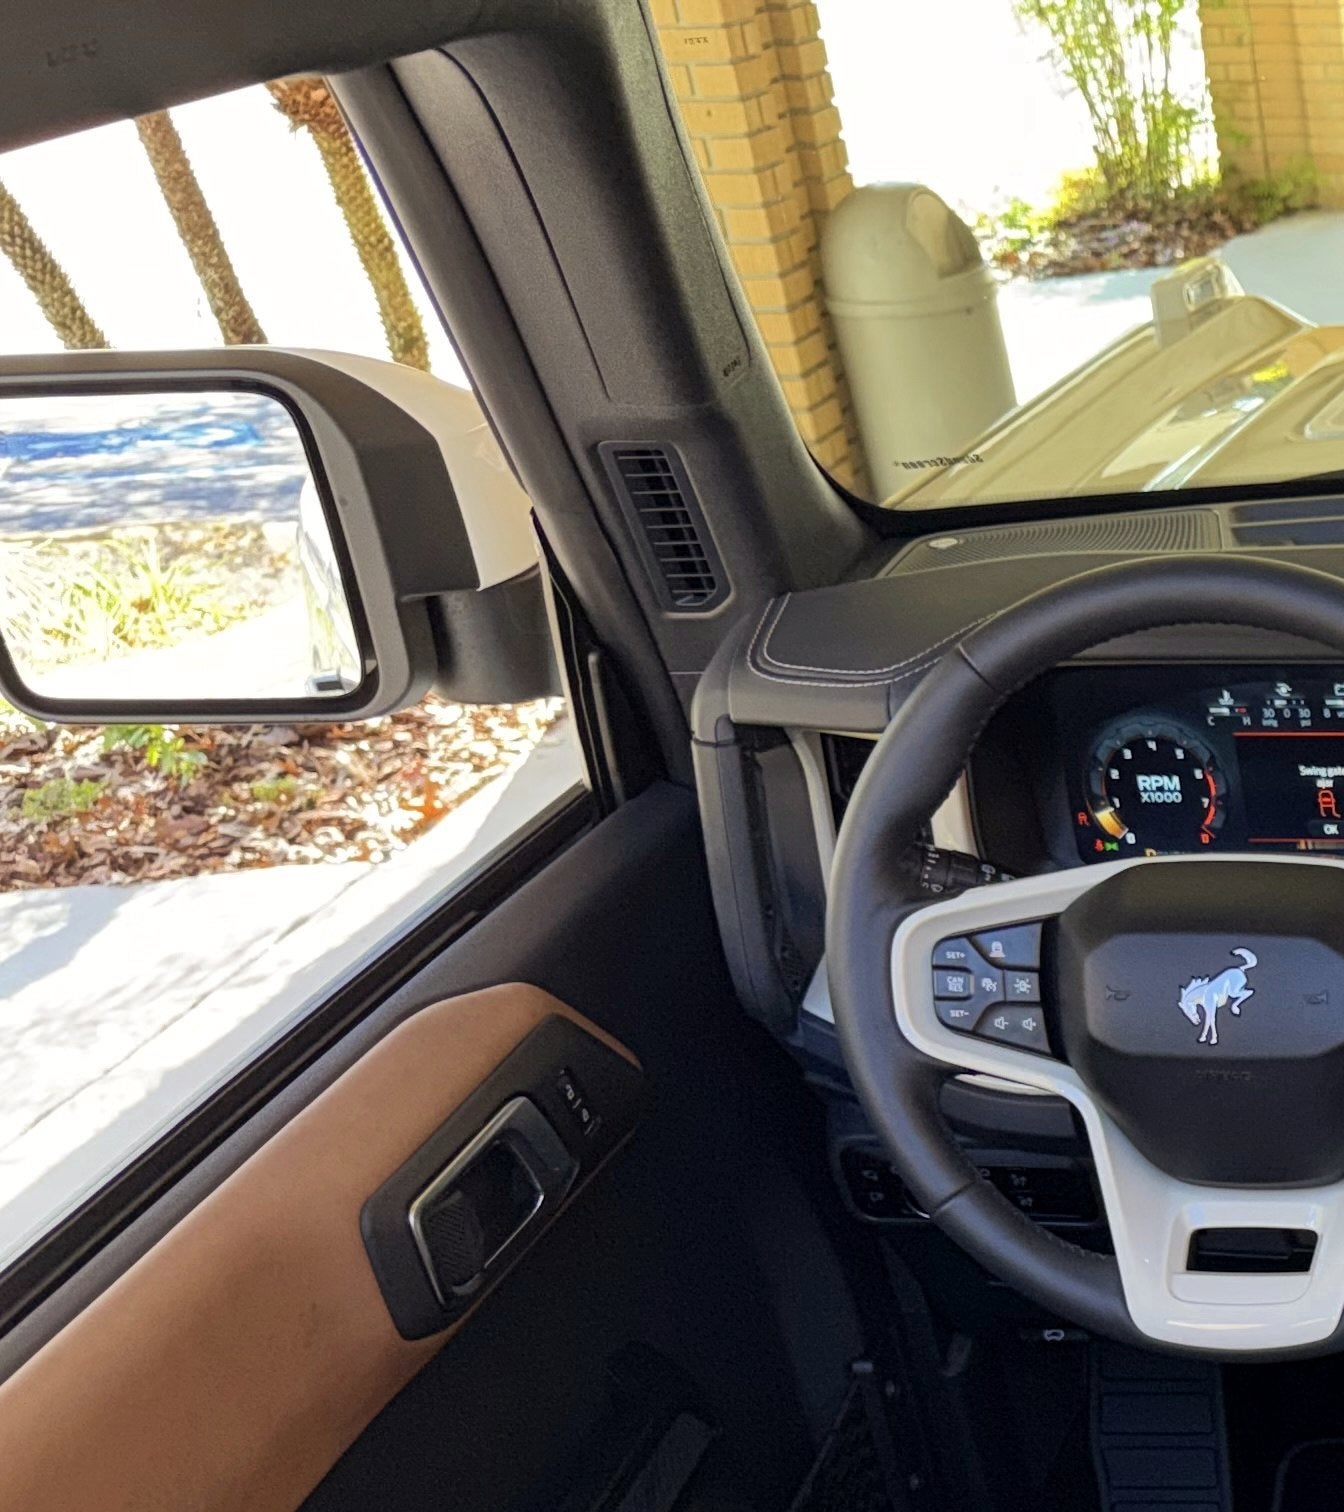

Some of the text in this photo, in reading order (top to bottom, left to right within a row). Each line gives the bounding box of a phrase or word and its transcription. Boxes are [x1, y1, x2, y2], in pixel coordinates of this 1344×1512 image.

[1110, 768, 1120, 780] 2
[1299, 764, 1327, 778] Swing
[1136, 774, 1181, 791] RPM
[1140, 791, 1182, 804] X1000
[1322, 823, 1340, 835] OK
